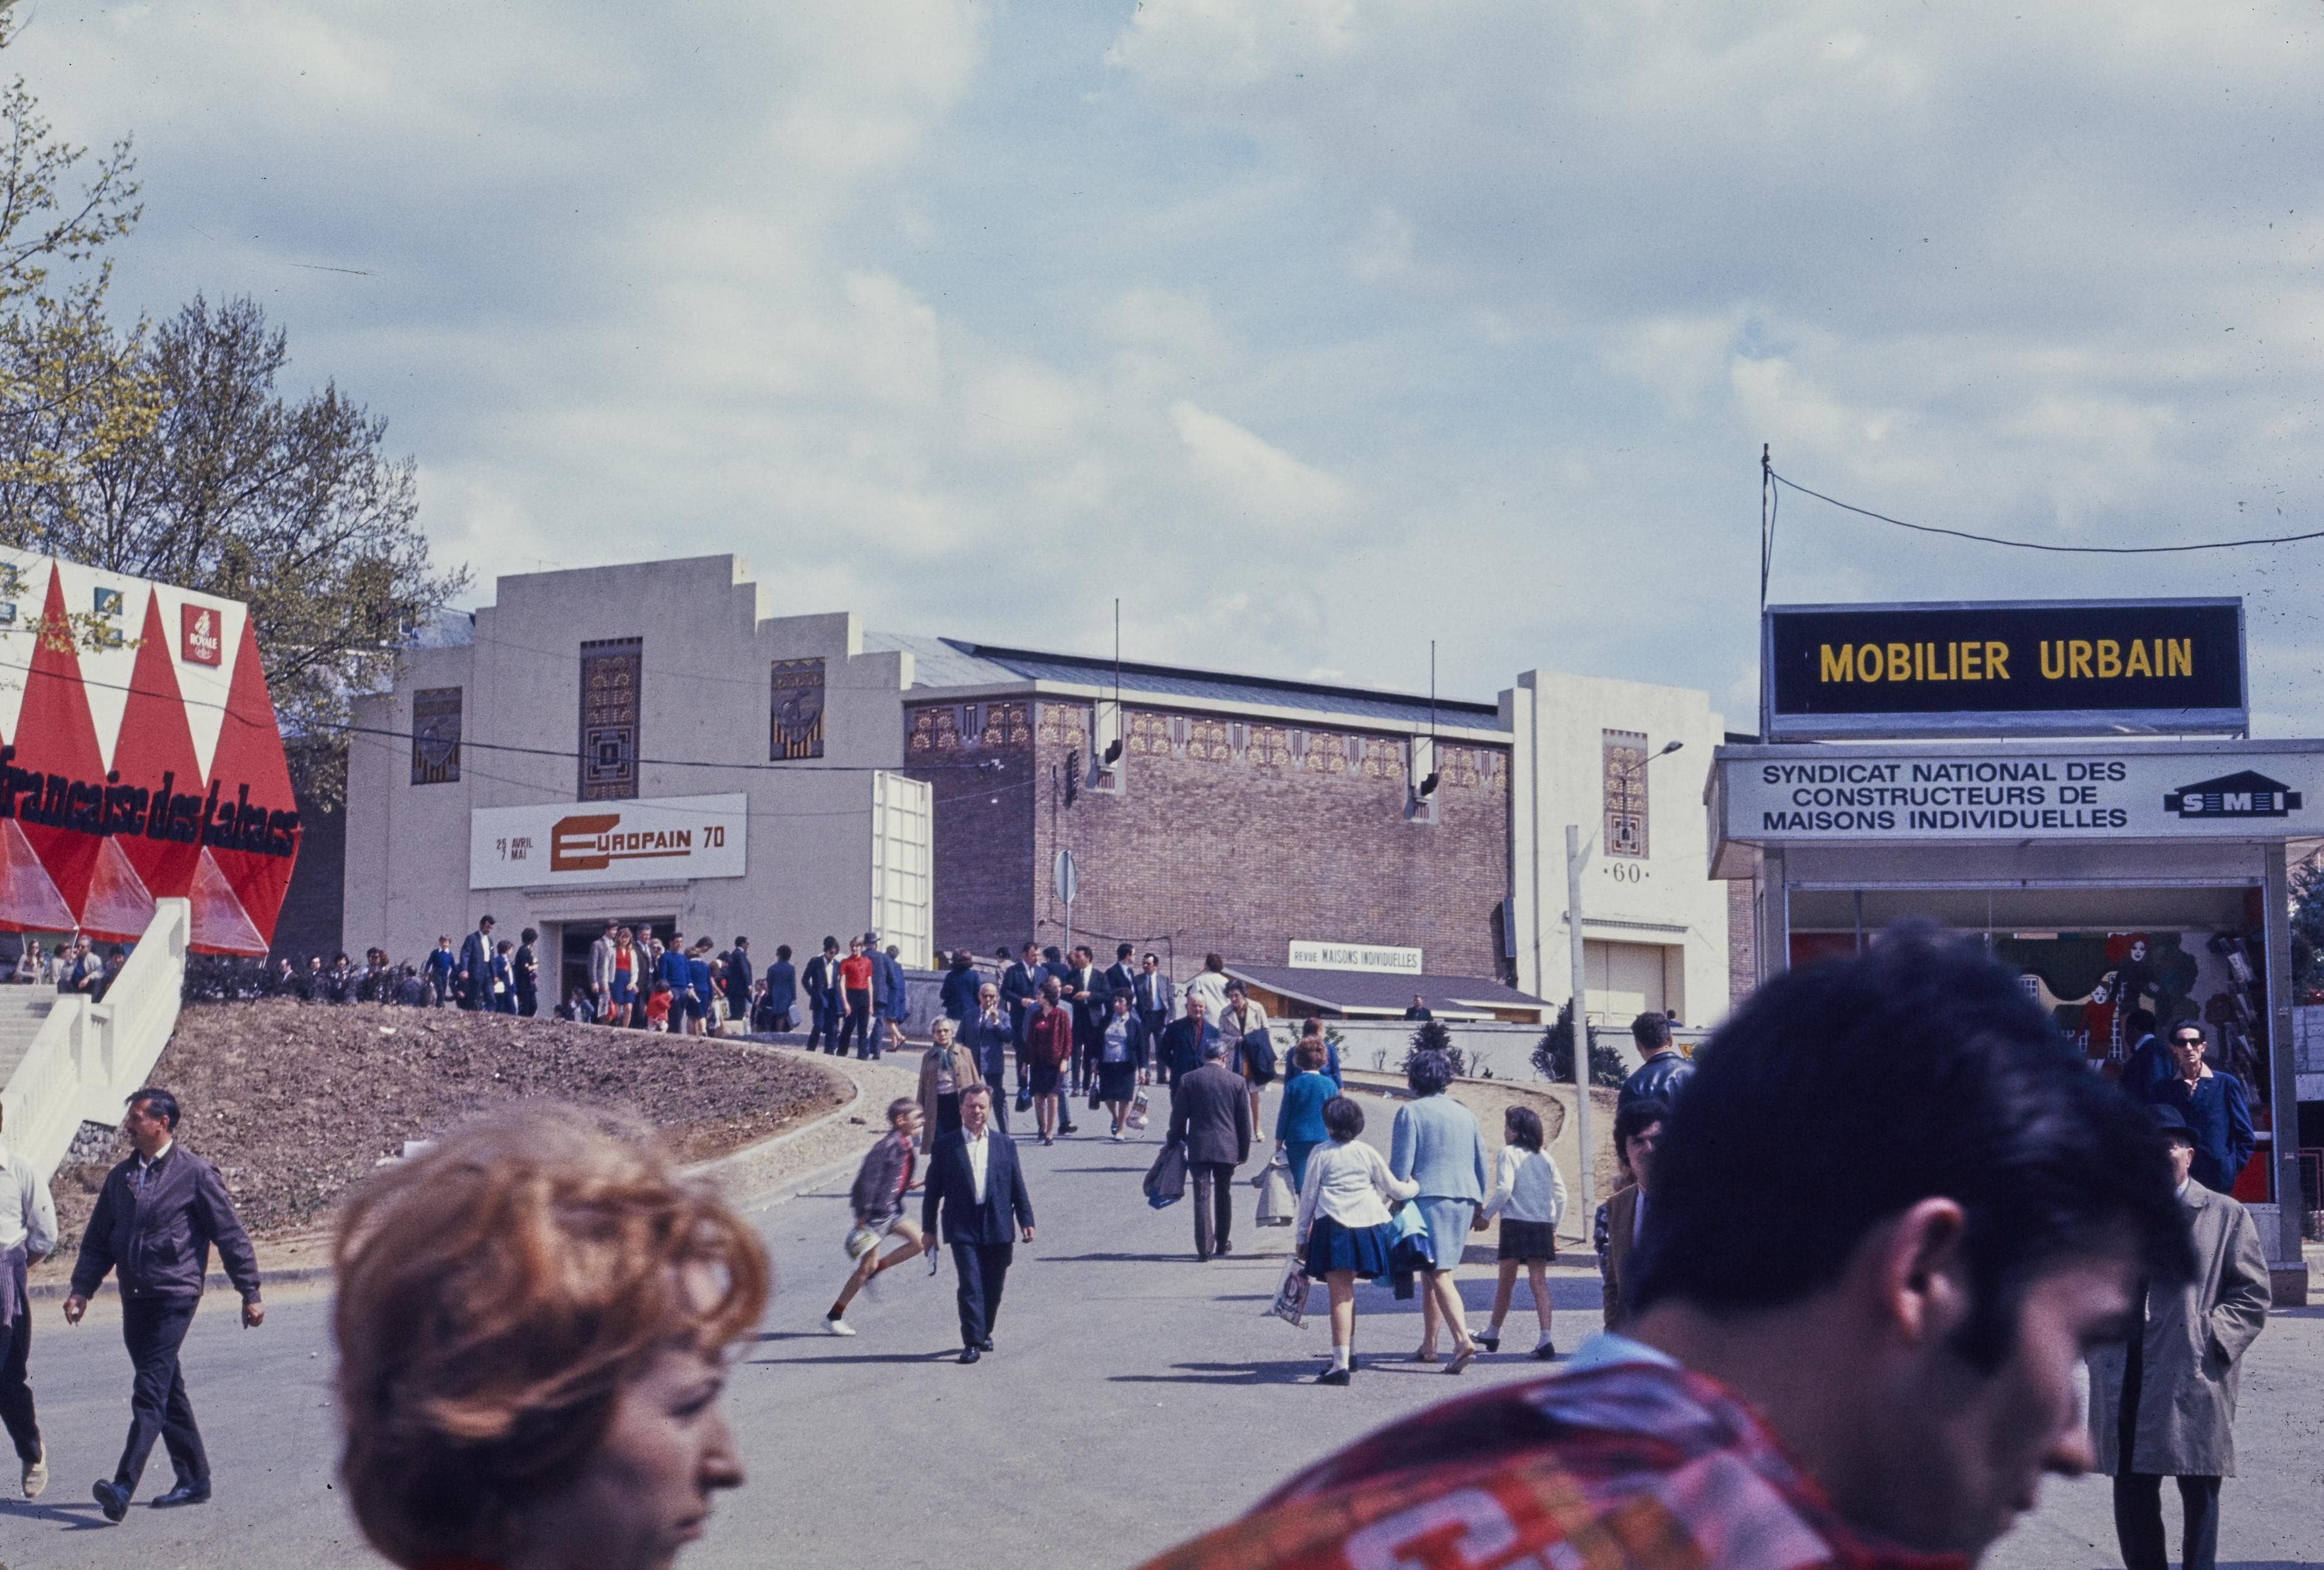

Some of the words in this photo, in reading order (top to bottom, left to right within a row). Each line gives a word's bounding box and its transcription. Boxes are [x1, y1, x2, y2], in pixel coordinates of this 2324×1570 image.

[190, 633, 217, 650] ROYALE
[1820, 641, 2010, 683] MOBILIER
[2040, 637, 2193, 679] URBAIN
[1762, 765, 1901, 784] SYNDICAT
[1913, 763, 2058, 783] NATIONAL
[2066, 762, 2126, 782] DES
[1792, 787, 2044, 807] CONSTRUCTEURS
[2059, 787, 2097, 805] DE
[146, 771, 202, 843] des
[201, 779, 300, 858] tabacs
[1763, 810, 1895, 831] MAISONS
[1910, 809, 2127, 829] INDIVIDUELLES
[512, 837, 533, 848] AVRIL
[550, 814, 692, 872] EUROPAIN
[703, 826, 725, 848] 70
[502, 849, 506, 860] 7
[511, 849, 526, 859] MAI
[1295, 951, 1318, 962] REVUE
[1322, 949, 1358, 964] MAISONS
[1361, 951, 1417, 968] INDIVIDUELLES
